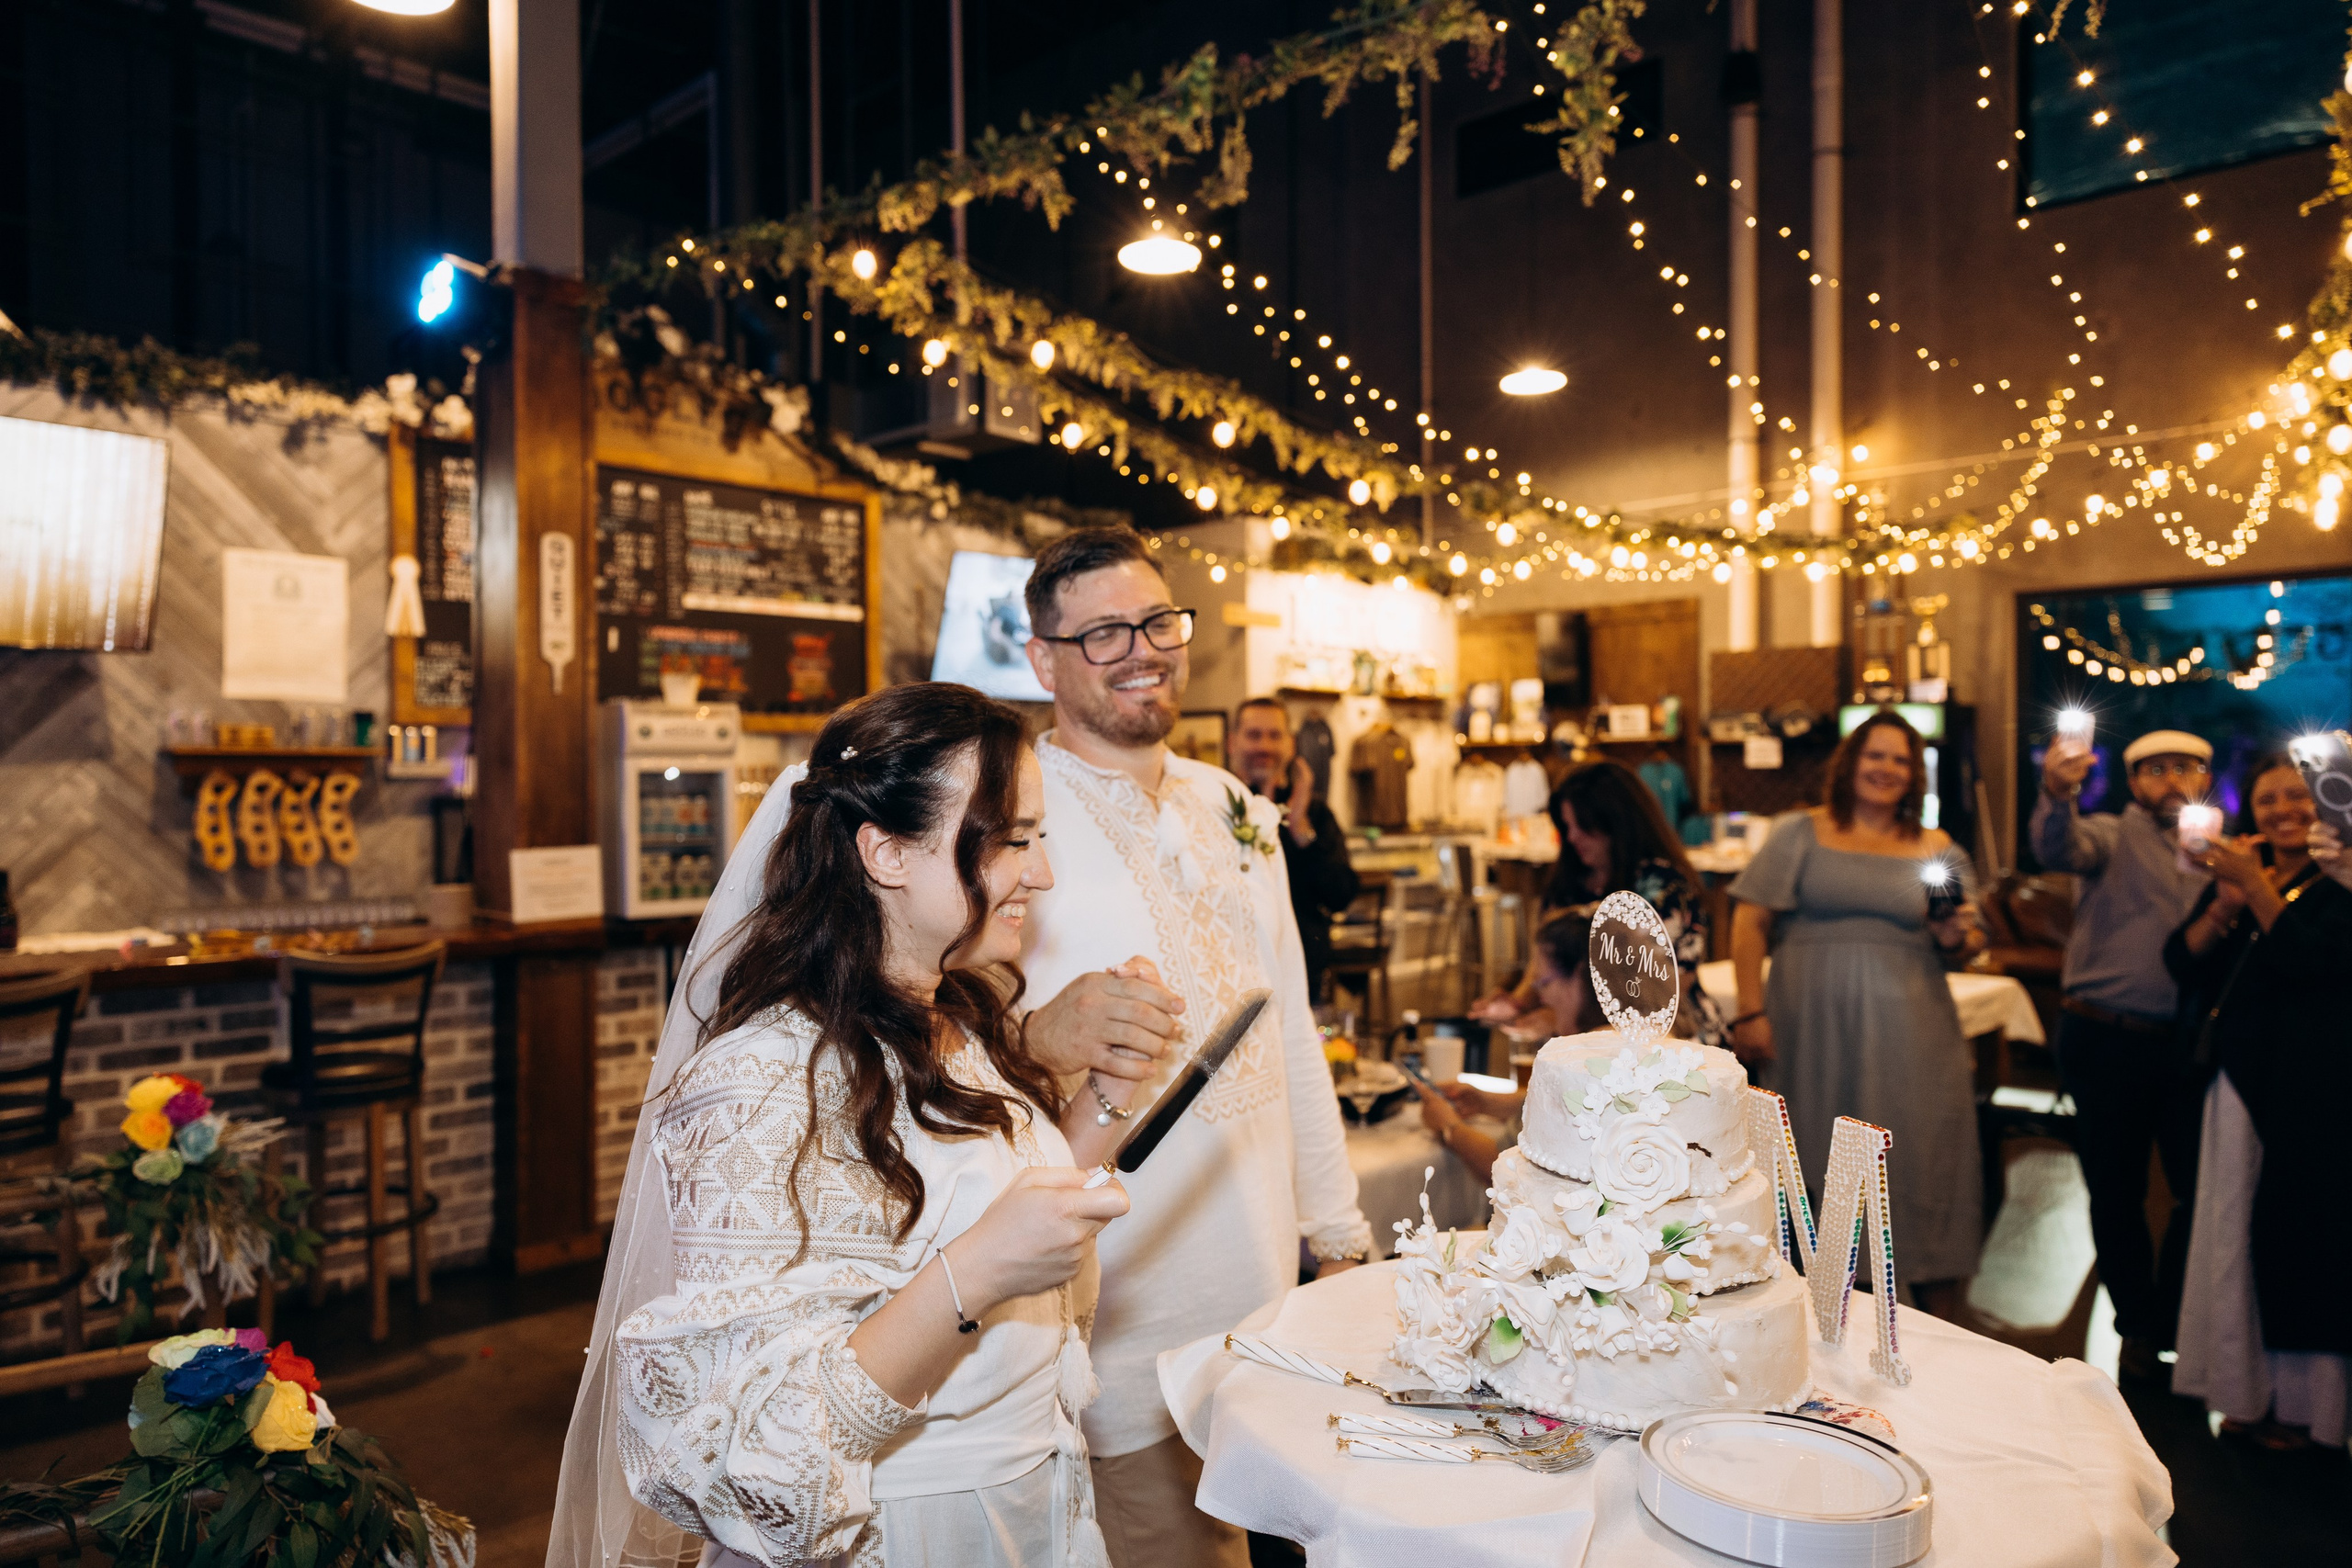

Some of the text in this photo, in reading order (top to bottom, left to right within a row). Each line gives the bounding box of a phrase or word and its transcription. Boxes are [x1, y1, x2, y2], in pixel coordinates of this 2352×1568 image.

[1599, 931, 1670, 982] Mr & Mrs
